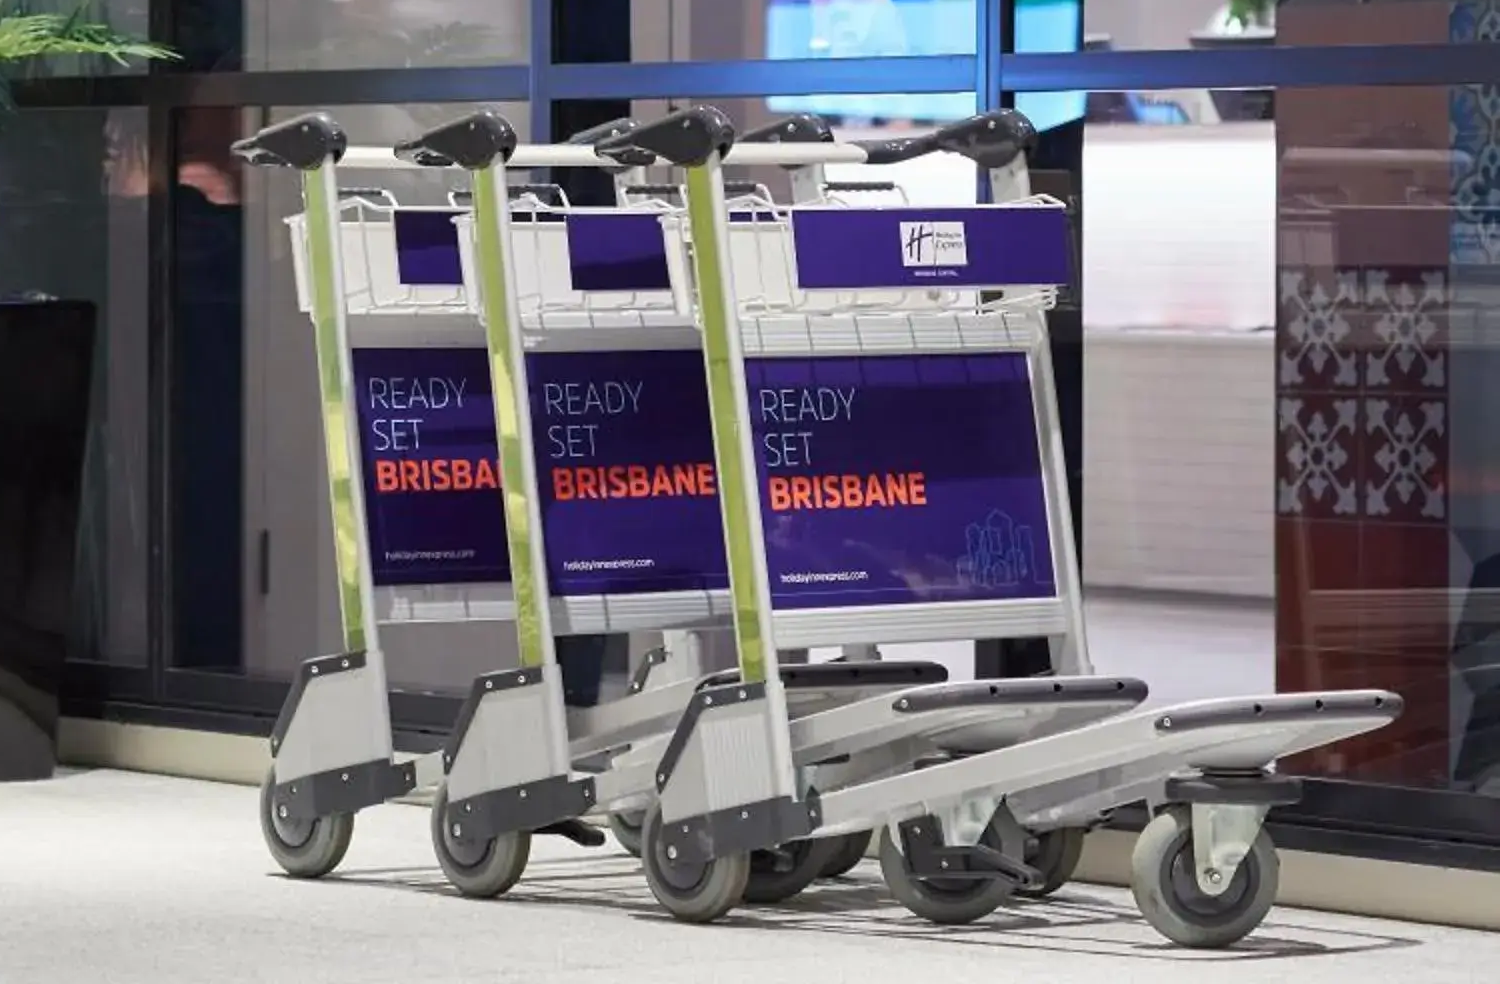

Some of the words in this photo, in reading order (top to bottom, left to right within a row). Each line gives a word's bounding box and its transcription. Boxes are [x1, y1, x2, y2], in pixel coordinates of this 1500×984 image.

[369, 377, 467, 409] READY
[543, 380, 644, 415] READY
[759, 387, 855, 422] READY
[372, 419, 424, 451] SET
[547, 424, 598, 458] SET
[763, 432, 813, 466] SET
[376, 457, 502, 492] BRISBA
[552, 463, 717, 500] BRISBANE
[769, 471, 928, 511] BRISBANE
